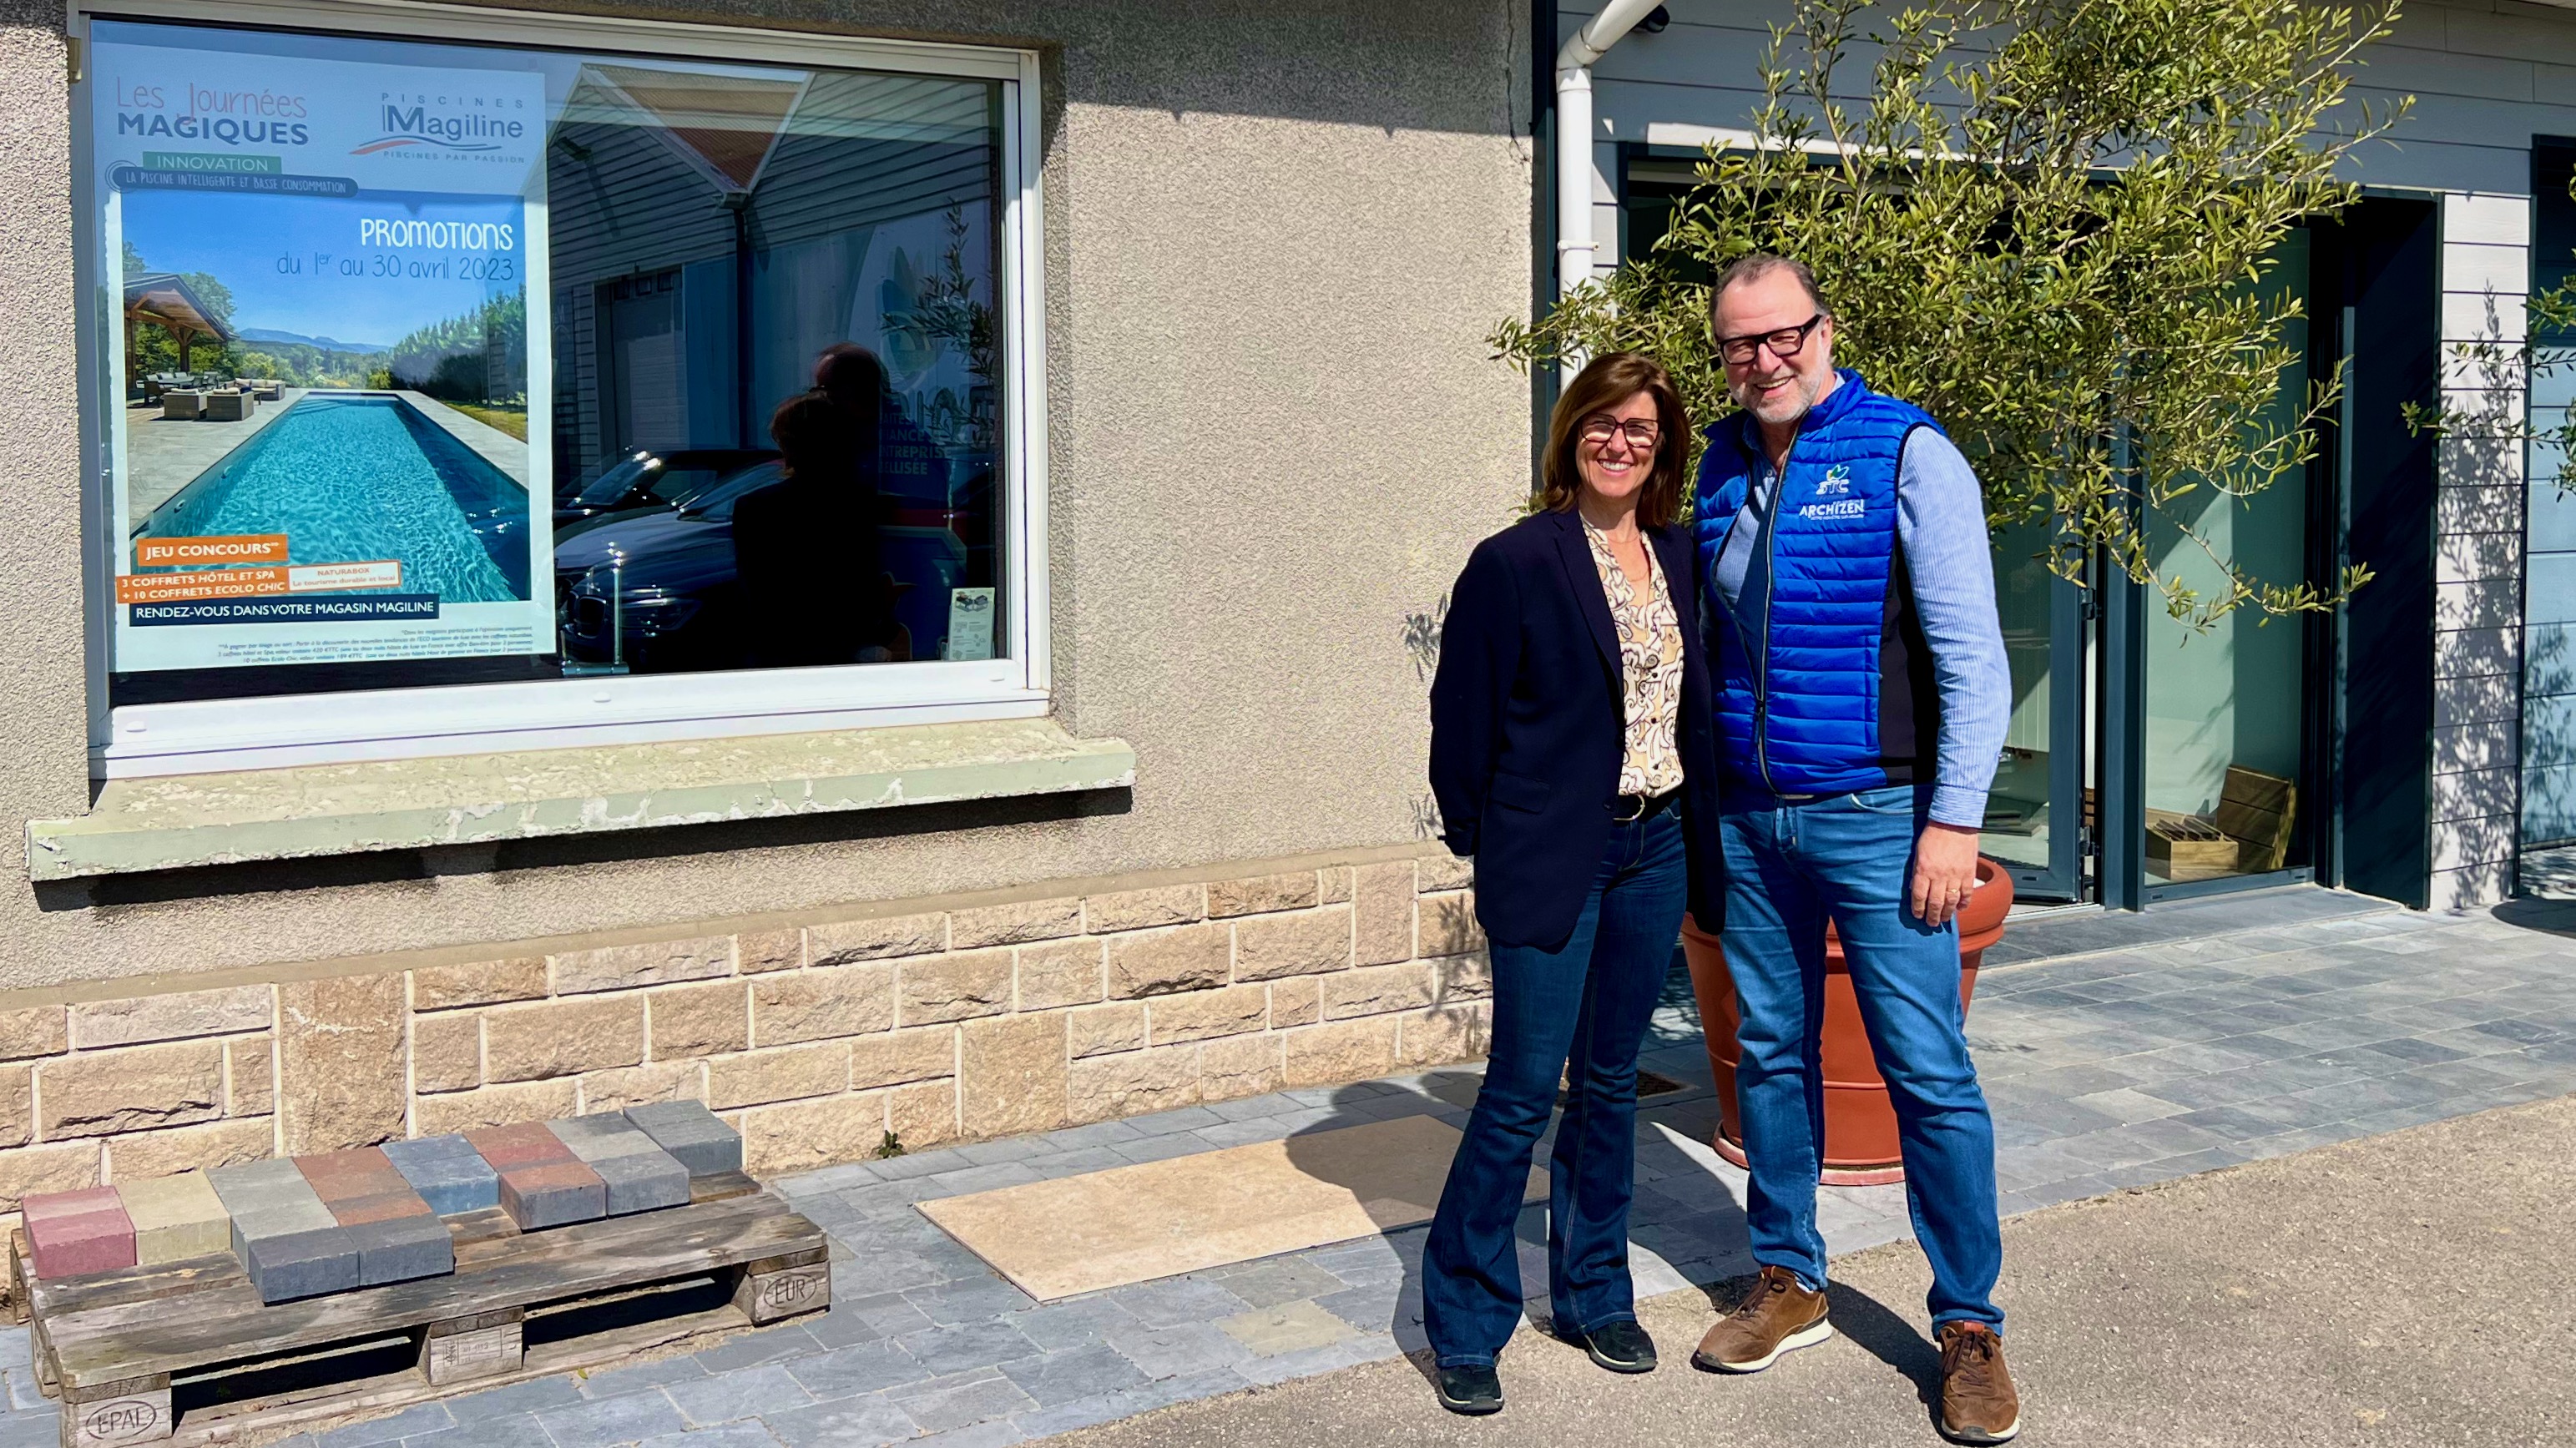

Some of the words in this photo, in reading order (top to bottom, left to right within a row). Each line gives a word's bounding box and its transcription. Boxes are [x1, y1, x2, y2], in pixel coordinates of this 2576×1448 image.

[117, 77, 164, 108] Les
[177, 83, 307, 125] Journées
[381, 93, 523, 108] PISCINES
[118, 113, 309, 145] MAGIQUES
[382, 104, 523, 141] Magiline
[157, 155, 268, 172] INNOVATION
[383, 151, 439, 160] PISCINES
[446, 154, 468, 162] PAR
[474, 155, 525, 164] PASSION
[126, 172, 136, 184] LA
[140, 173, 174, 185] PISCINE
[178, 174, 235, 188] INTELLIGENTE
[240, 176, 248, 188] ET
[253, 176, 278, 190] BASSE
[281, 178, 346, 194] CONSOMMATION
[360, 218, 513, 251] PROMOTIONS
[277, 252, 301, 275] du
[340, 259, 363, 276] au
[372, 255, 401, 278] 30
[409, 256, 449, 280] avril
[459, 257, 513, 280] 2023
[145, 546, 174, 561] JEU
[122, 578, 129, 588] 3
[131, 574, 195, 588] COFFRETS
[198, 571, 237, 583] HÔTEL
[240, 572, 253, 581] ET
[255, 570, 275, 580] SPA
[317, 567, 370, 577] NATURABOX
[134, 591, 146, 600] 10
[149, 586, 212, 599] COFFRETS
[215, 583, 255, 596] ECOLO
[257, 582, 285, 593] CHIC
[136, 605, 230, 618] RENDEZ-VOUS
[233, 605, 270, 616] DANS
[270, 603, 312, 616] VOTRE
[315, 603, 373, 614] MAGASIN
[376, 602, 434, 613] MAGILINE
[775, 1279, 806, 1304] EUR
[98, 1407, 148, 1434] EPAL
